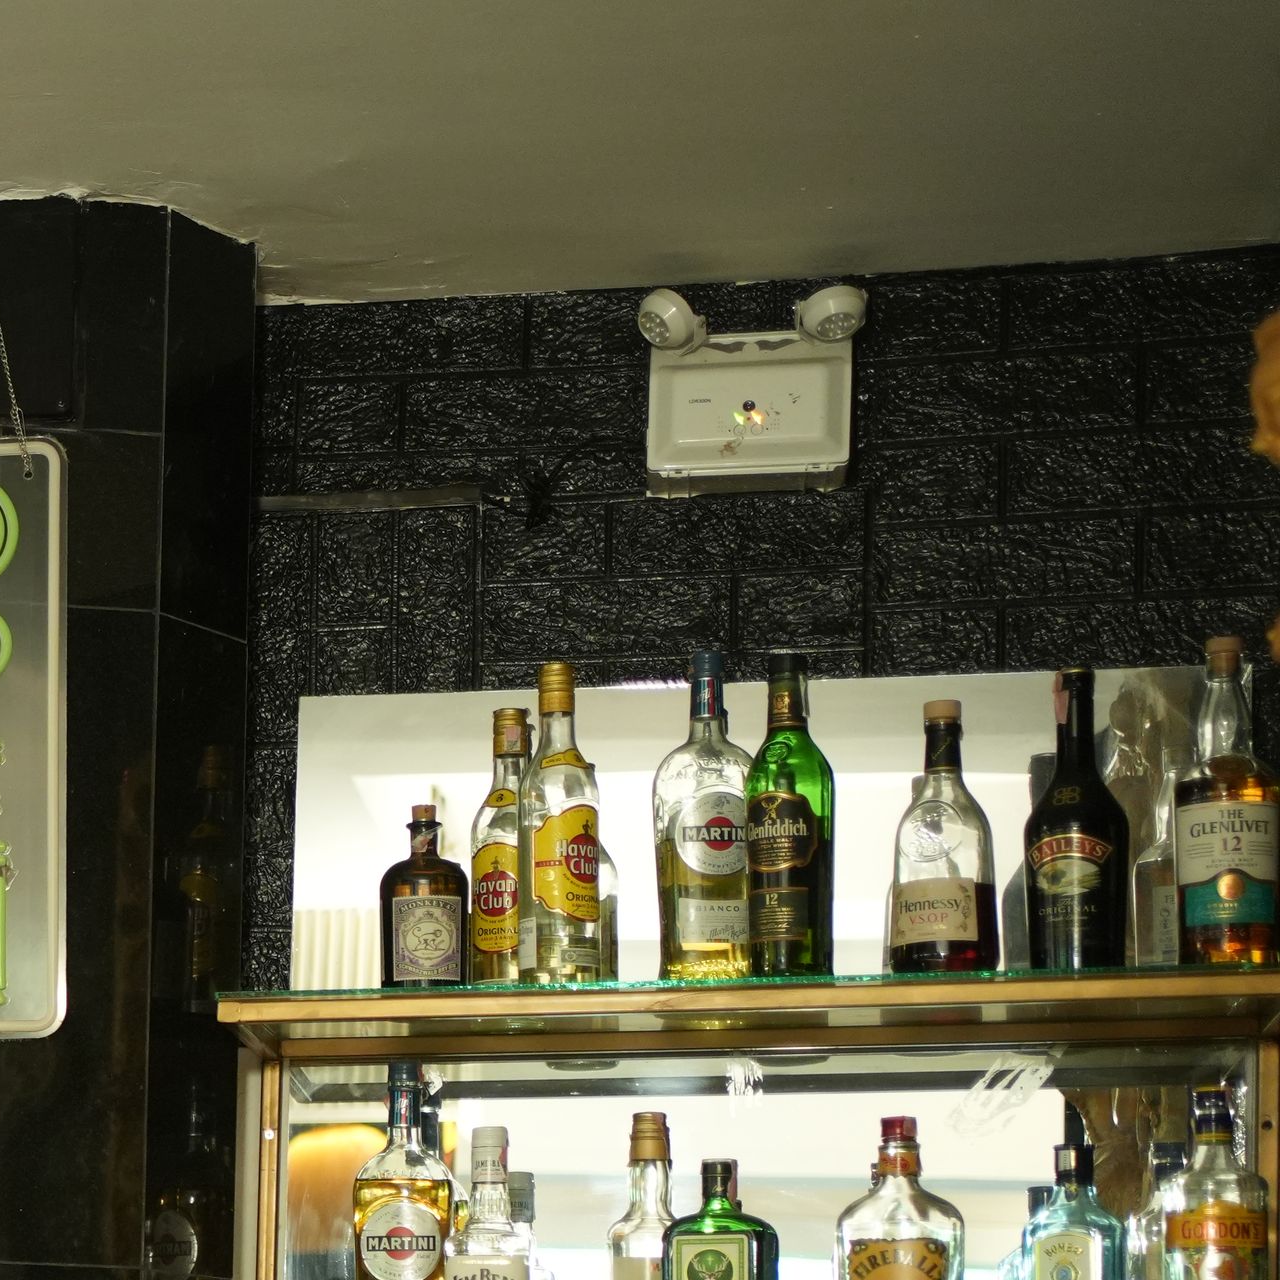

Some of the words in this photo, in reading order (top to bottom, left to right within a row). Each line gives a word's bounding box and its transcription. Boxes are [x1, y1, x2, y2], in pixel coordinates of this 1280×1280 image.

[1218, 809, 1244, 819] THE
[684, 826, 746, 841] MARTIN
[747, 818, 808, 842] Glenfiddich
[1190, 820, 1270, 838] GLENLIVET
[556, 839, 599, 858] Havan
[1031, 838, 1107, 863] BAILEYS
[1221, 836, 1243, 851] 12
[570, 857, 599, 875] Club
[472, 876, 519, 896] Havan
[400, 900, 446, 912] MONKEY
[480, 892, 513, 911] Club
[765, 893, 778, 905] 12
[900, 898, 961, 914] Hennessy
[1038, 904, 1097, 915] ORIGINAL
[368, 1237, 435, 1250] MARTINI
